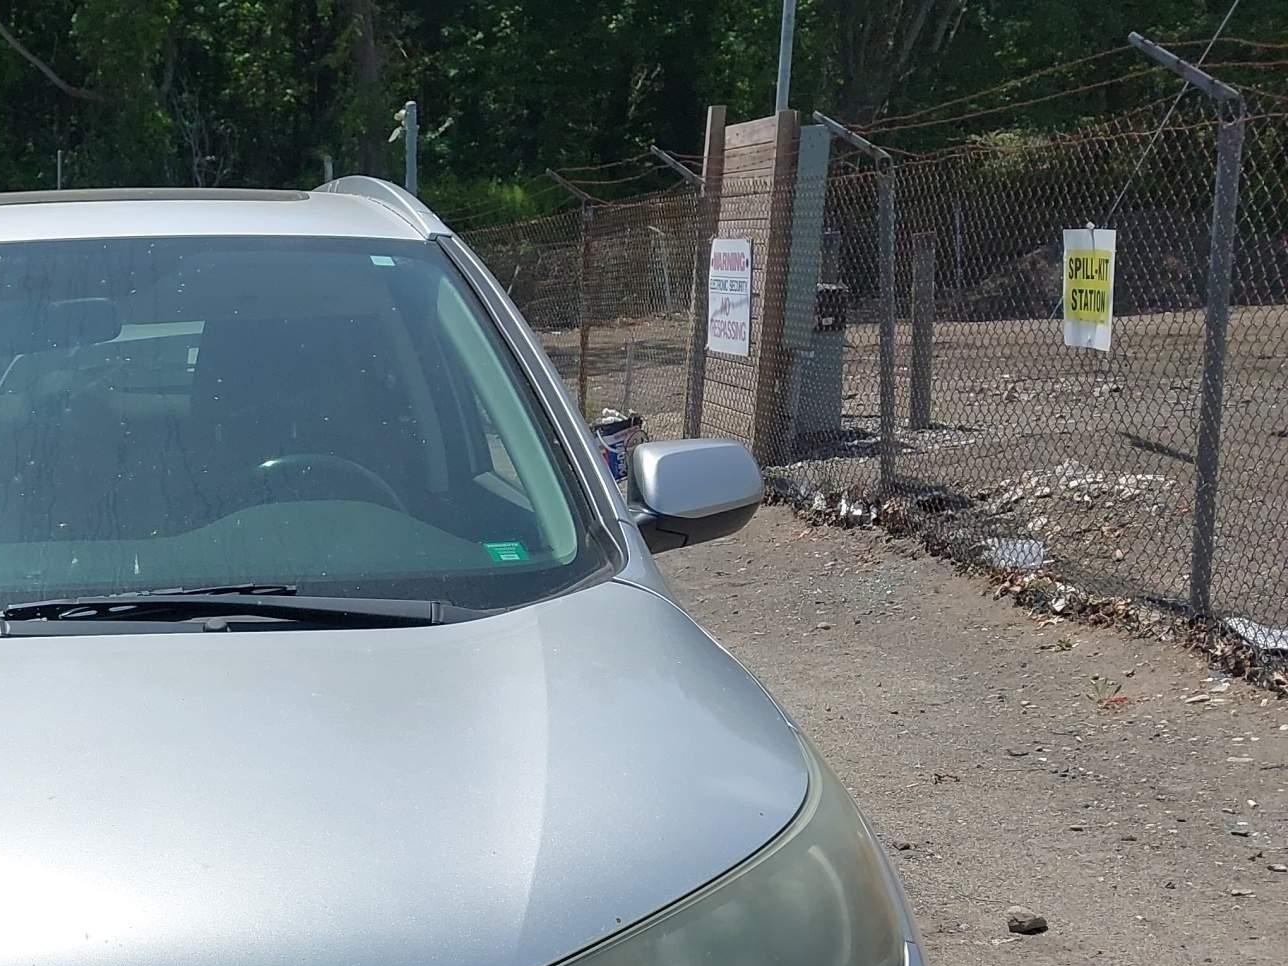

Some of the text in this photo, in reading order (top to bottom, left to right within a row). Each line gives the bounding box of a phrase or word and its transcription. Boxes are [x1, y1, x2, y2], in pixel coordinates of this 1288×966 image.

[713, 251, 745, 270] WARNING
[720, 295, 730, 316] NO
[1071, 288, 1105, 312] STATION
